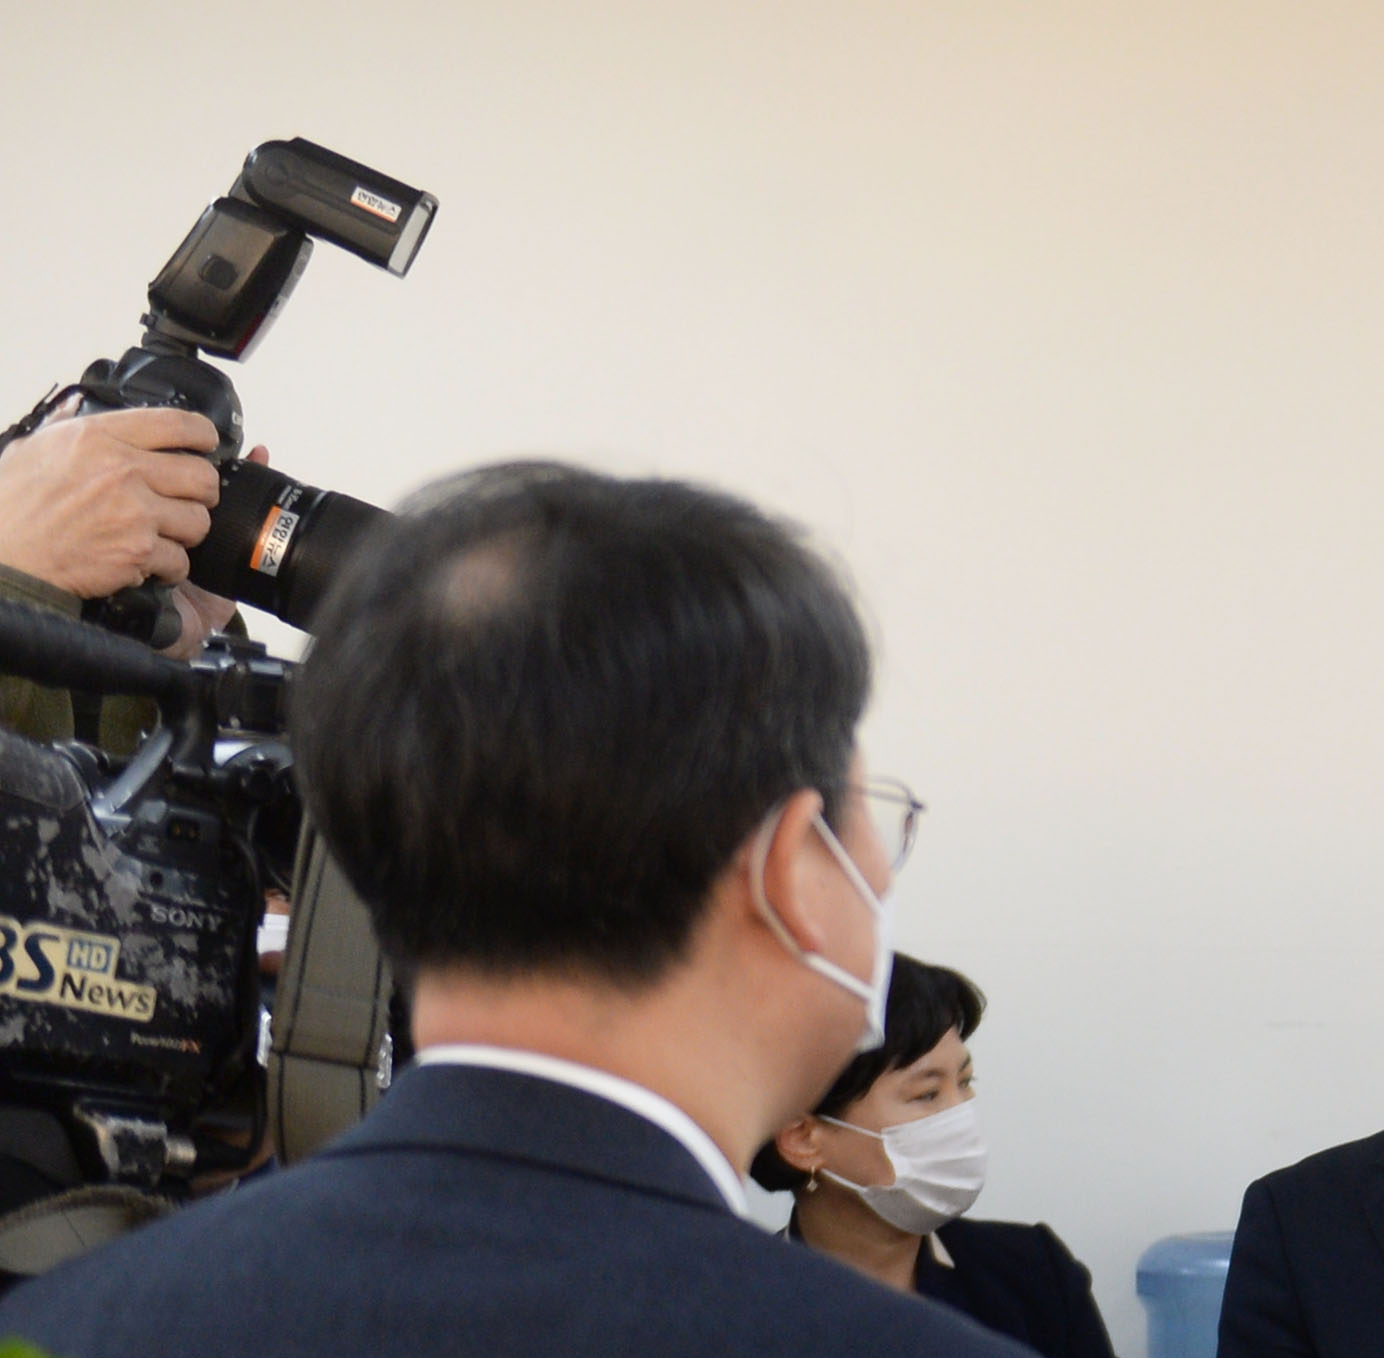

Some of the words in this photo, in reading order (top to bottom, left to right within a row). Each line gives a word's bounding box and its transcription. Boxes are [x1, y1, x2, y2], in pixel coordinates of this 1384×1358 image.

[150, 903, 222, 931] SONY
[70, 939, 109, 971] HD
[59, 972, 151, 1014] News
